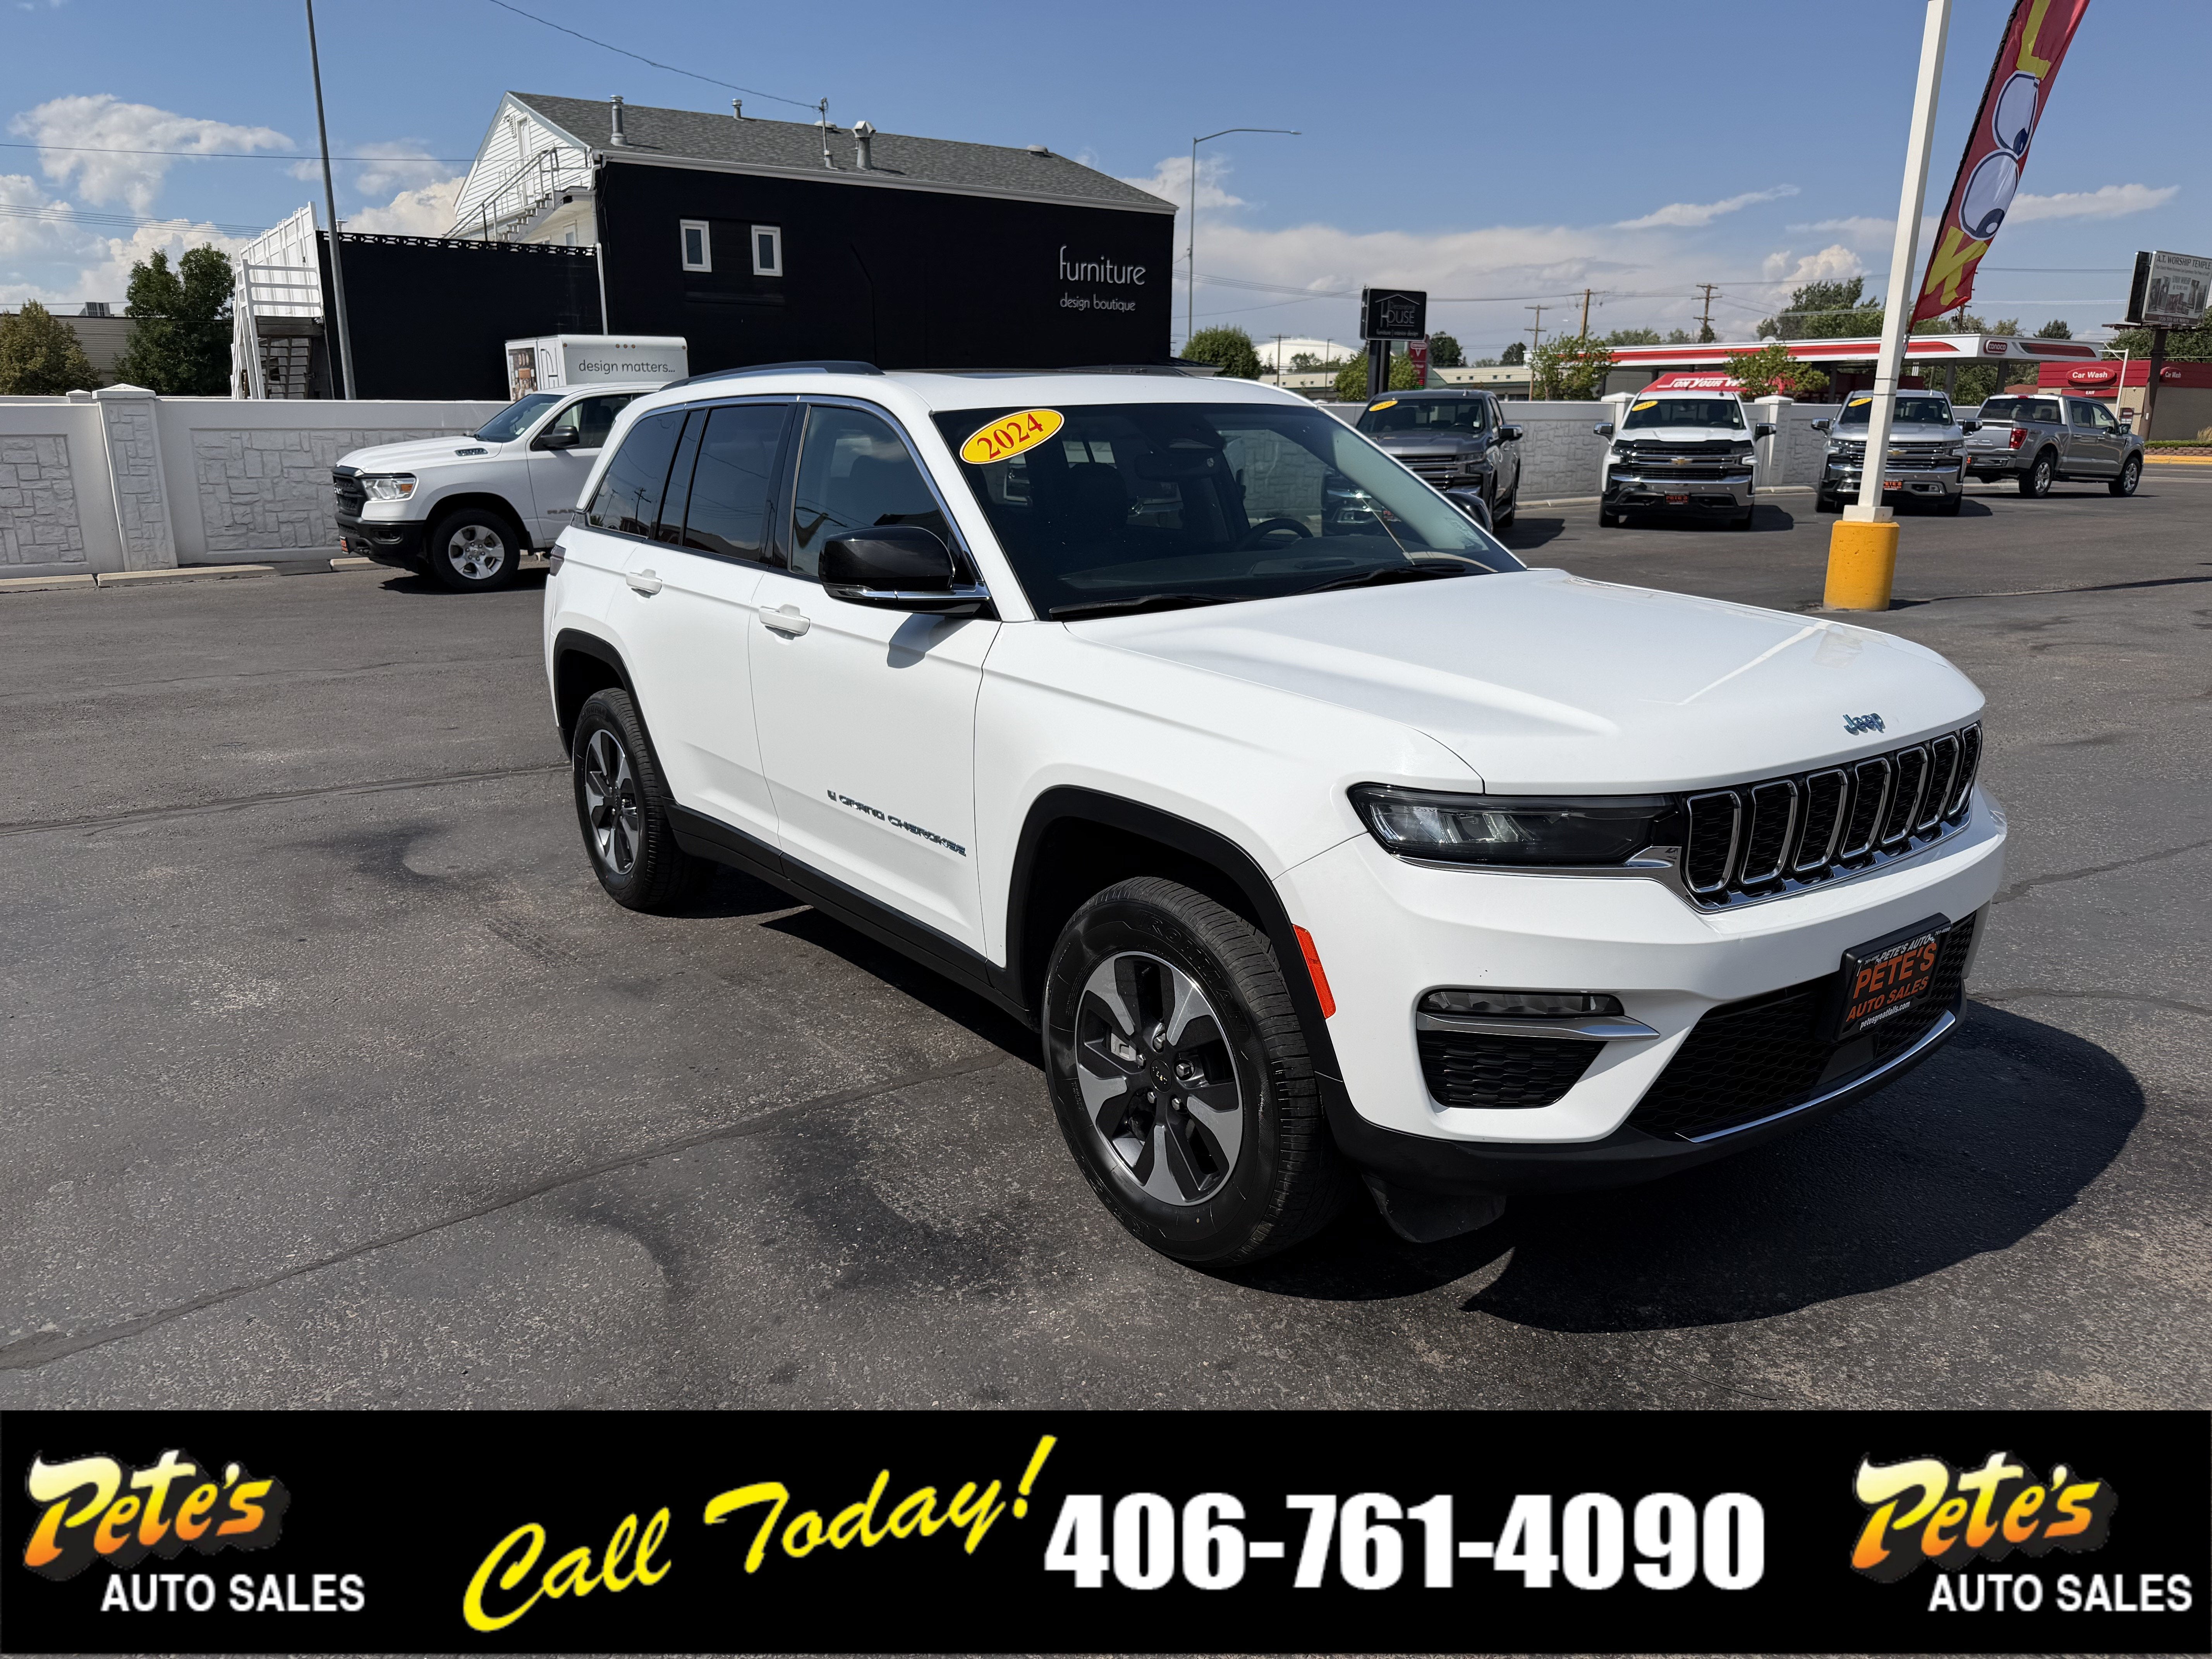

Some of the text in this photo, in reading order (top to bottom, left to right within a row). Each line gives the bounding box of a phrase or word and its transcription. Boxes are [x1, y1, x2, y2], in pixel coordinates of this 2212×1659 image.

[1060, 245, 1146, 285] furniture
[2168, 256, 2191, 266] WORSHIP
[2192, 259, 2212, 270] TEMPLE
[1060, 292, 1136, 313] design boutique
[1380, 299, 1415, 327] HOUSE
[579, 359, 675, 374] design matters...
[1691, 377, 1723, 388] YOUR
[977, 413, 1044, 459] 2024
[1843, 713, 1886, 736] Jeep
[838, 794, 967, 857] GRAND CHEROKEE
[1880, 934, 1932, 961] PETE'S AUTO
[1853, 942, 1937, 1000] PETE'S
[1846, 975, 1930, 1022] AUTO SALES
[1859, 1001, 1911, 1030] petesgreatfalls.com
